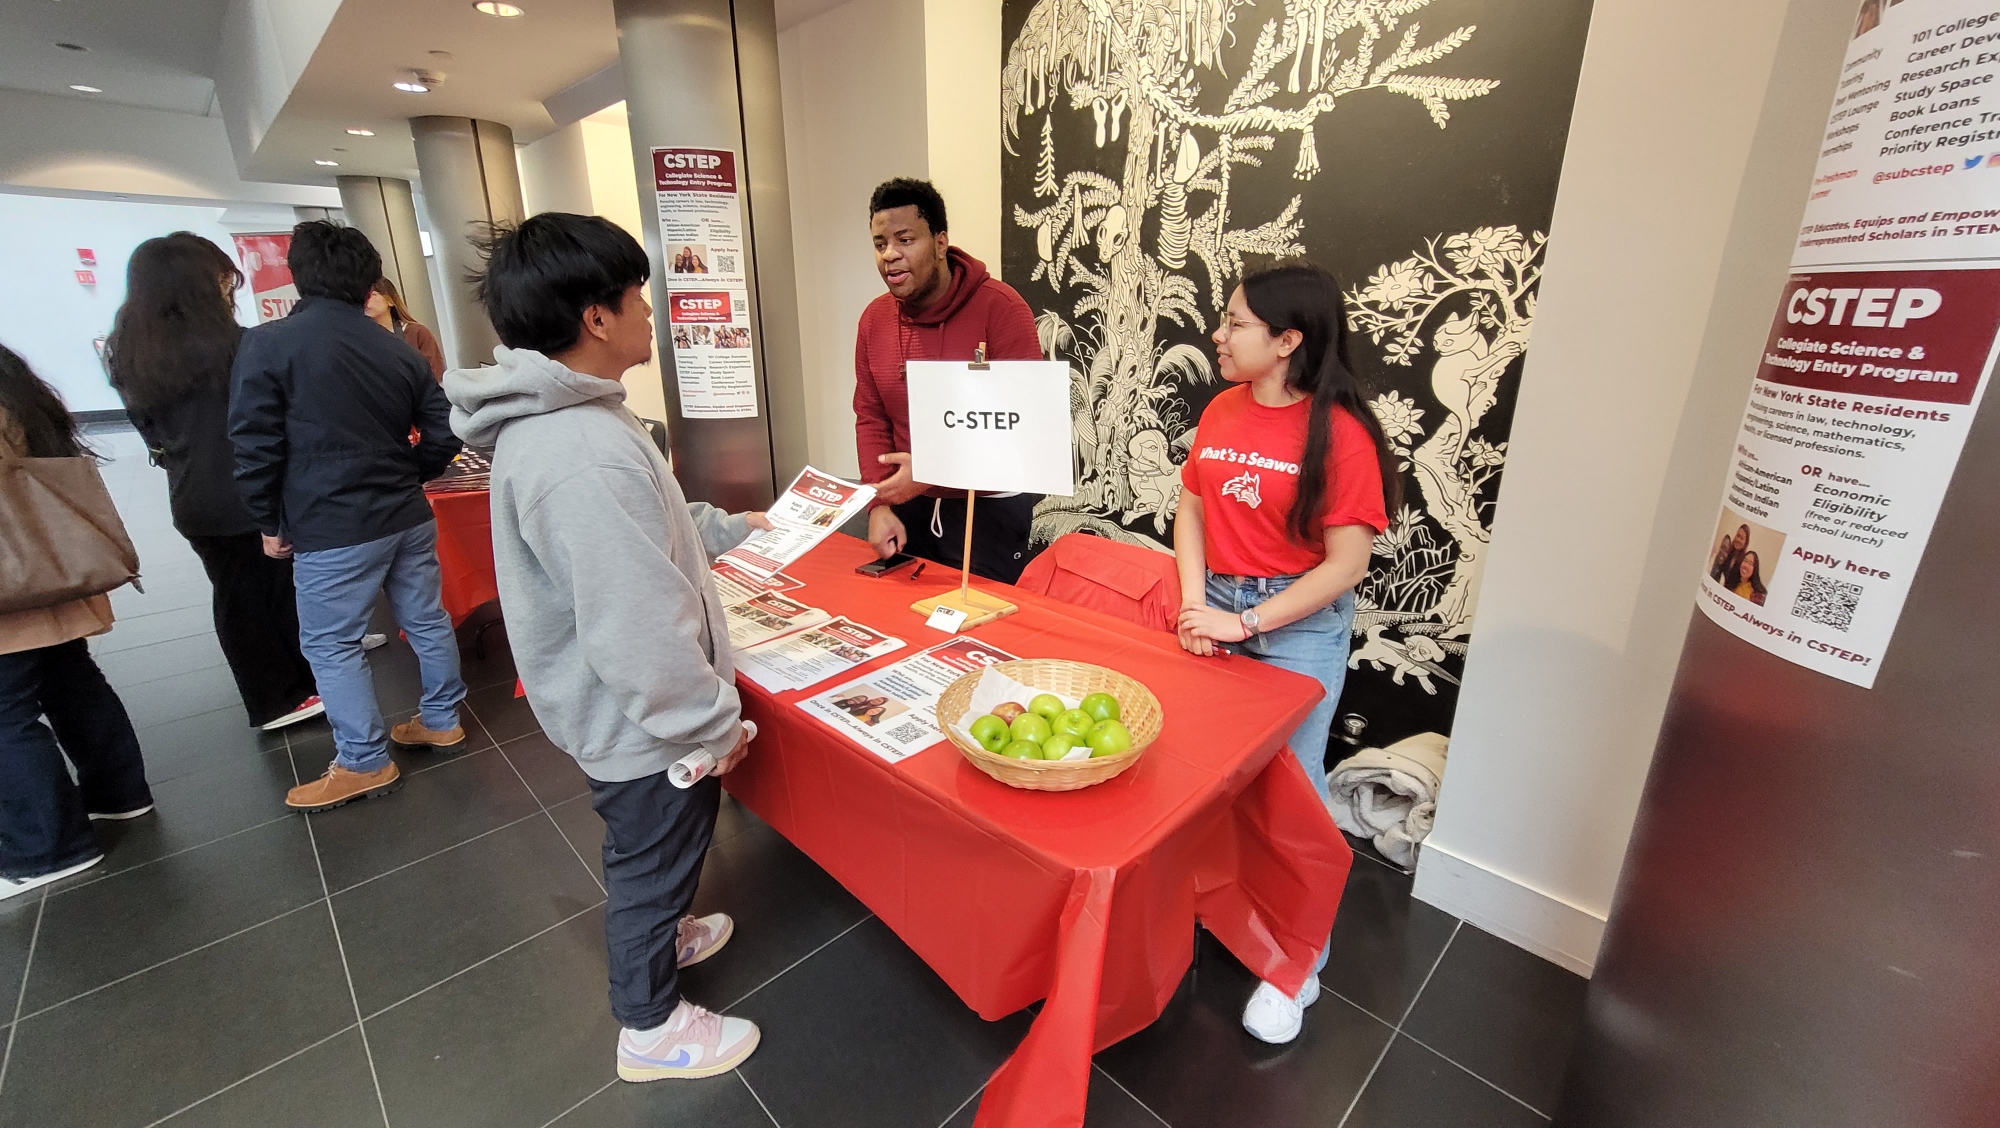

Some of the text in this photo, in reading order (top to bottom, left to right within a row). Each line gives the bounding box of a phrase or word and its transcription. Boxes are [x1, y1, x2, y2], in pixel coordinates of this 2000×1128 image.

[1912, 11, 2000, 44] 101 College
[1845, 48, 1884, 73] Community
[1907, 42, 1956, 63] Career
[1900, 51, 2000, 84] Research Ex
[1848, 79, 1891, 100] Mentoring
[1894, 73, 1993, 103] Study Space
[1848, 100, 1879, 117] Lounge
[1890, 96, 1981, 122] Book Loans
[1884, 117, 1972, 141] Conference
[1879, 140, 1932, 157] Priority
[663, 153, 721, 169] CSTEP
[1872, 163, 1955, 185] @subcstep
[1853, 216, 1895, 230] Equips
[1897, 212, 1928, 224] and
[1867, 228, 1927, 242] Scholars
[1931, 226, 1948, 237] in
[679, 299, 722, 310] CSTEP
[1787, 287, 1942, 328] CSTEP
[1777, 337, 1926, 360] Collegiate Science &
[1764, 353, 1959, 384] Technology Entry Program
[1763, 386, 1779, 400] New
[1780, 390, 1803, 404] York
[1806, 394, 1847, 410] State
[1851, 401, 1951, 422] Residents
[943, 410, 1020, 430] C-STEP
[1768, 405, 1794, 419] careers
[1795, 410, 1804, 420] in
[1807, 413, 1828, 426] law,
[1831, 417, 1917, 439] technology,
[1763, 429, 1793, 446] licensed
[1793, 438, 1866, 459] professions.
[1776, 421, 1810, 436] science,
[1812, 429, 1906, 452] mathematics,
[1238, 454, 1246, 464] a
[1246, 452, 1301, 475] Seawo
[1800, 464, 1871, 488] OR have...
[809, 486, 843, 502] CSTEP
[1754, 491, 1780, 509] Indian
[1813, 483, 1892, 507] Economic
[1746, 501, 1769, 519] native
[1812, 498, 1887, 523] Eligibility
[1801, 521, 1884, 548] school lunch)
[1805, 509, 1908, 540] (free or reduced
[1792, 546, 1891, 581] Apply here
[766, 600, 797, 612] CSTEP
[839, 625, 873, 641] CSTEP
[1787, 631, 1802, 644] in
[1807, 639, 1872, 667] CSTEP!
[931, 662, 942, 670] New
[946, 668, 961, 677] York
[810, 700, 824, 710] Once
[881, 742, 905, 758] CSTEP!
[908, 713, 928, 726] Apply
